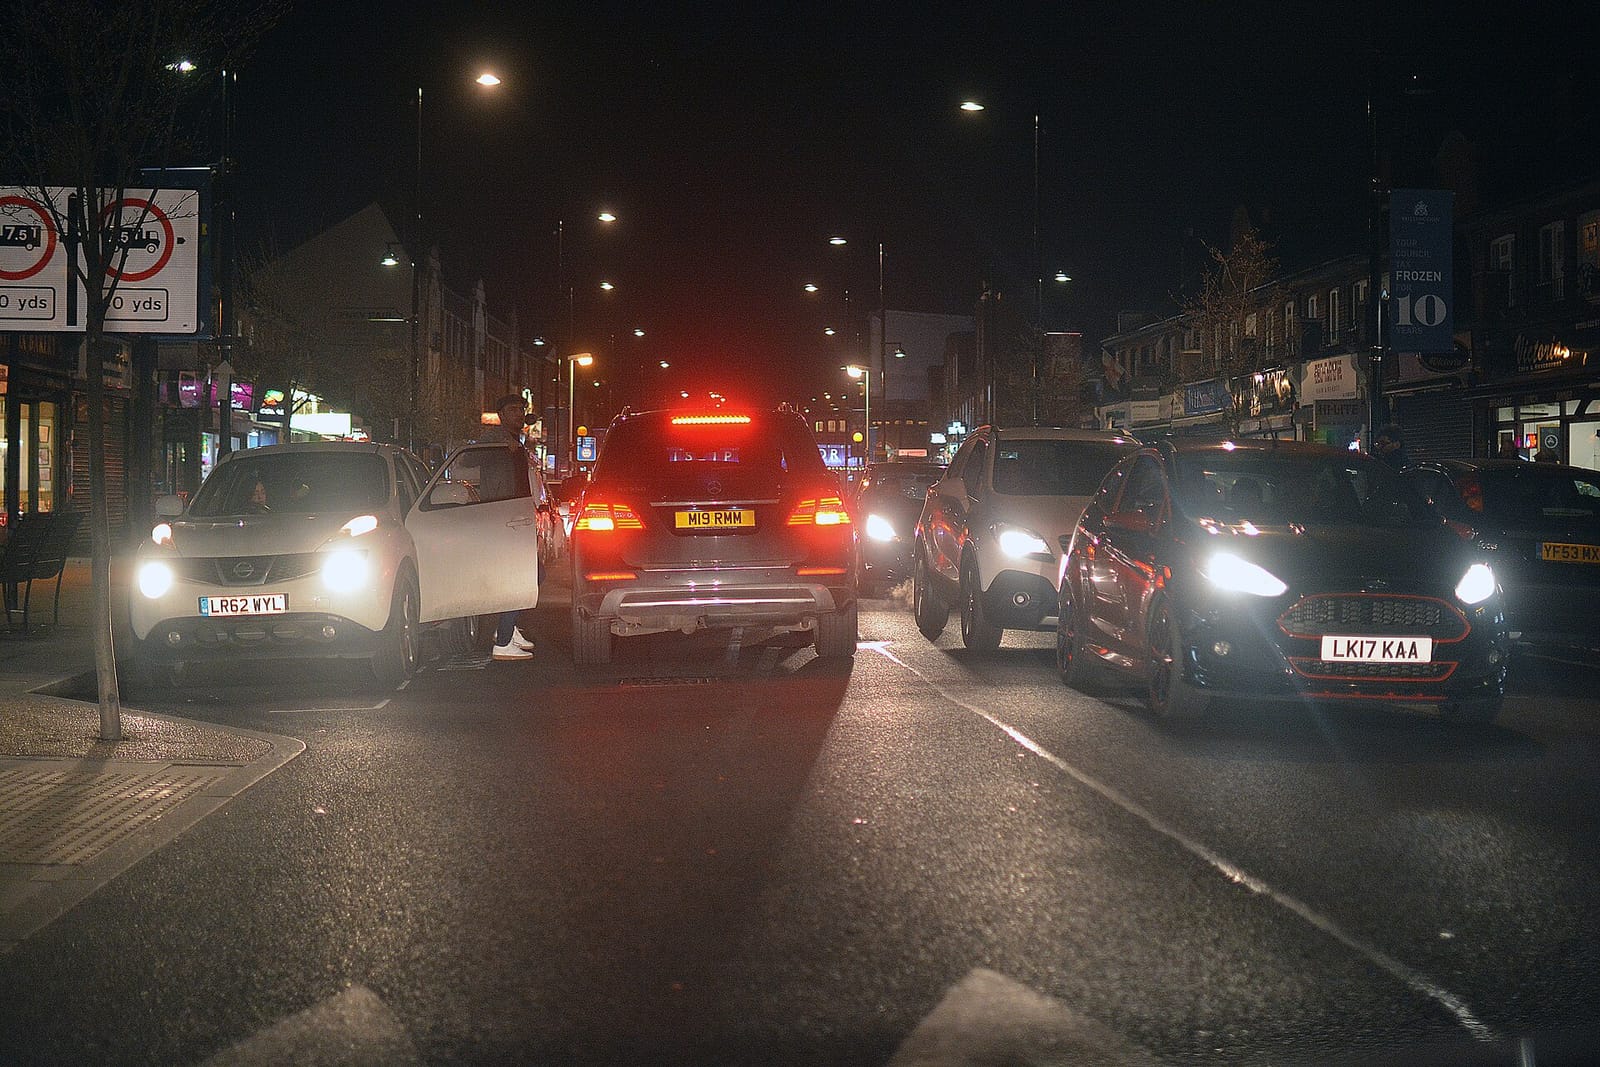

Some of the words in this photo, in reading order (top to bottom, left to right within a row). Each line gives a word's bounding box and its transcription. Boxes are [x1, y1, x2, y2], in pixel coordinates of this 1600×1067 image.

[1395, 270, 1442, 282] FROZEN
[18, 295, 48, 311] yds
[132, 297, 162, 312] yds
[1395, 292, 1447, 327] 10
[688, 512, 710, 525] M19
[714, 511, 742, 525] RMM
[1543, 544, 1579, 559] YF53
[210, 598, 249, 613] LR62
[253, 597, 282, 611] WYL
[1333, 639, 1377, 658] LK17
[1381, 641, 1418, 659] KAA
